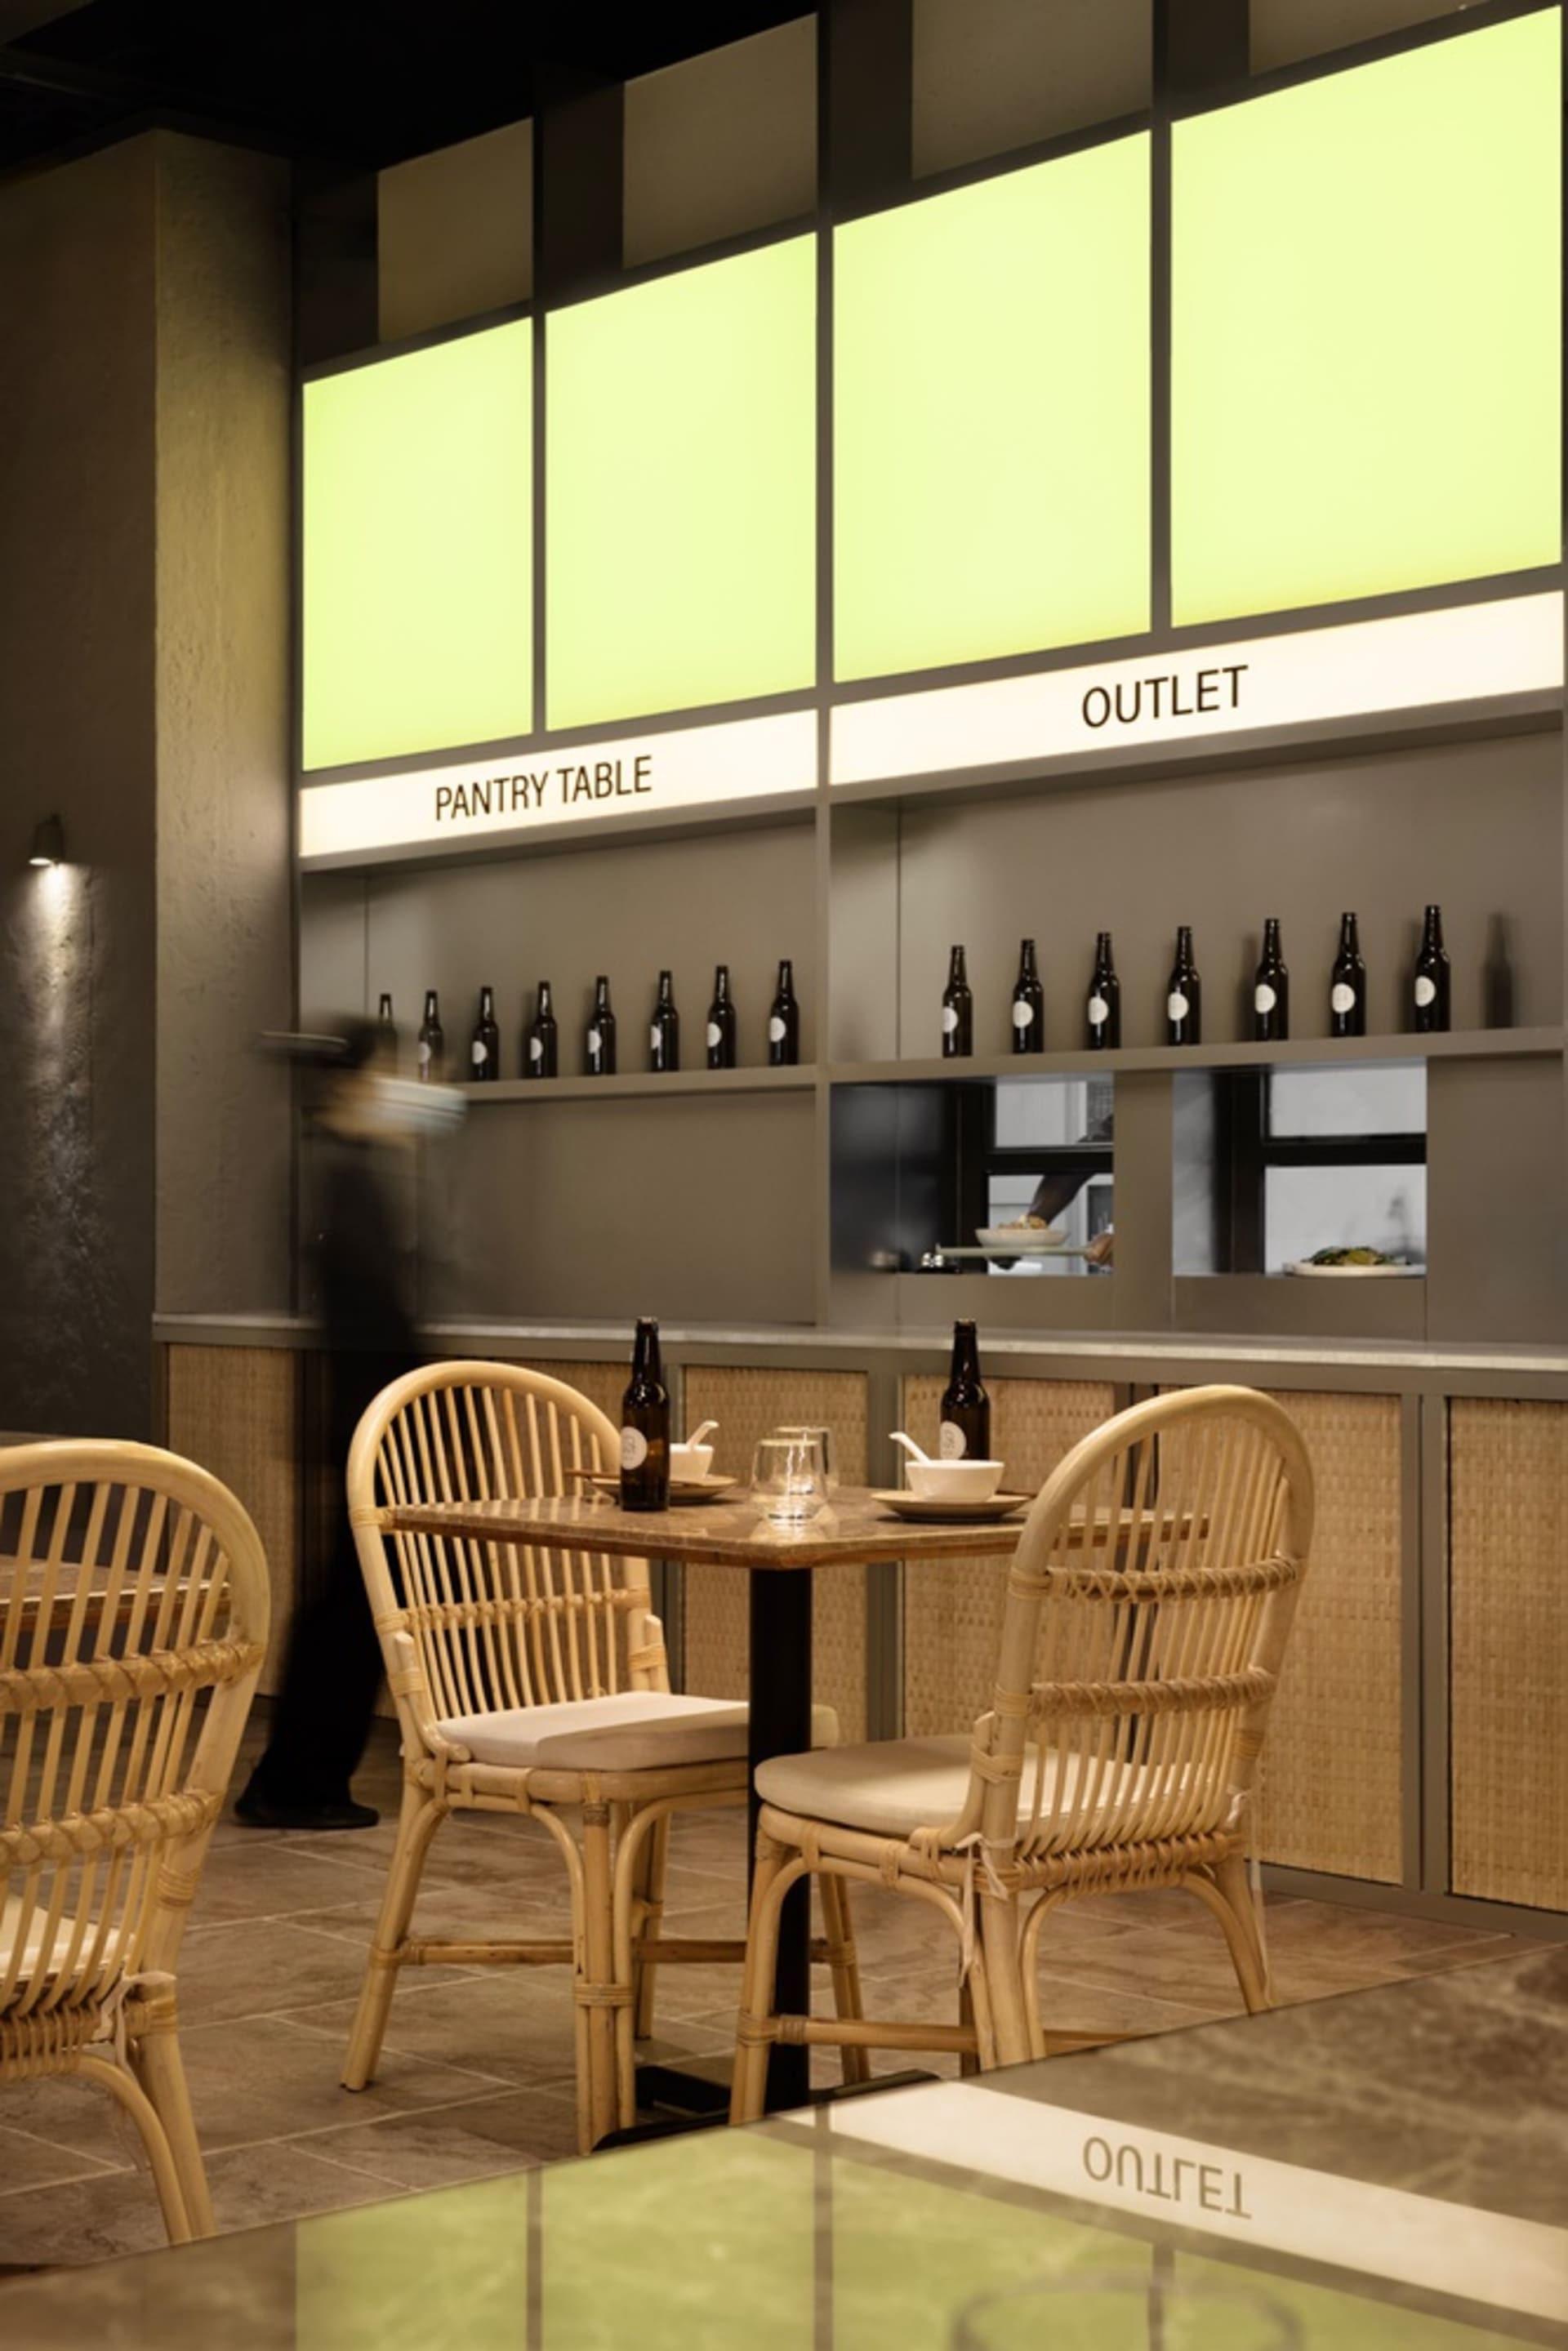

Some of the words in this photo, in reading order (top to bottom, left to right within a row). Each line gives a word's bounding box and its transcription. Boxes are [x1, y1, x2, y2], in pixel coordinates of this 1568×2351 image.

[1082, 665, 1249, 728] OUTLET
[436, 772, 548, 821] PANTRY
[557, 755, 652, 803] TABLE
